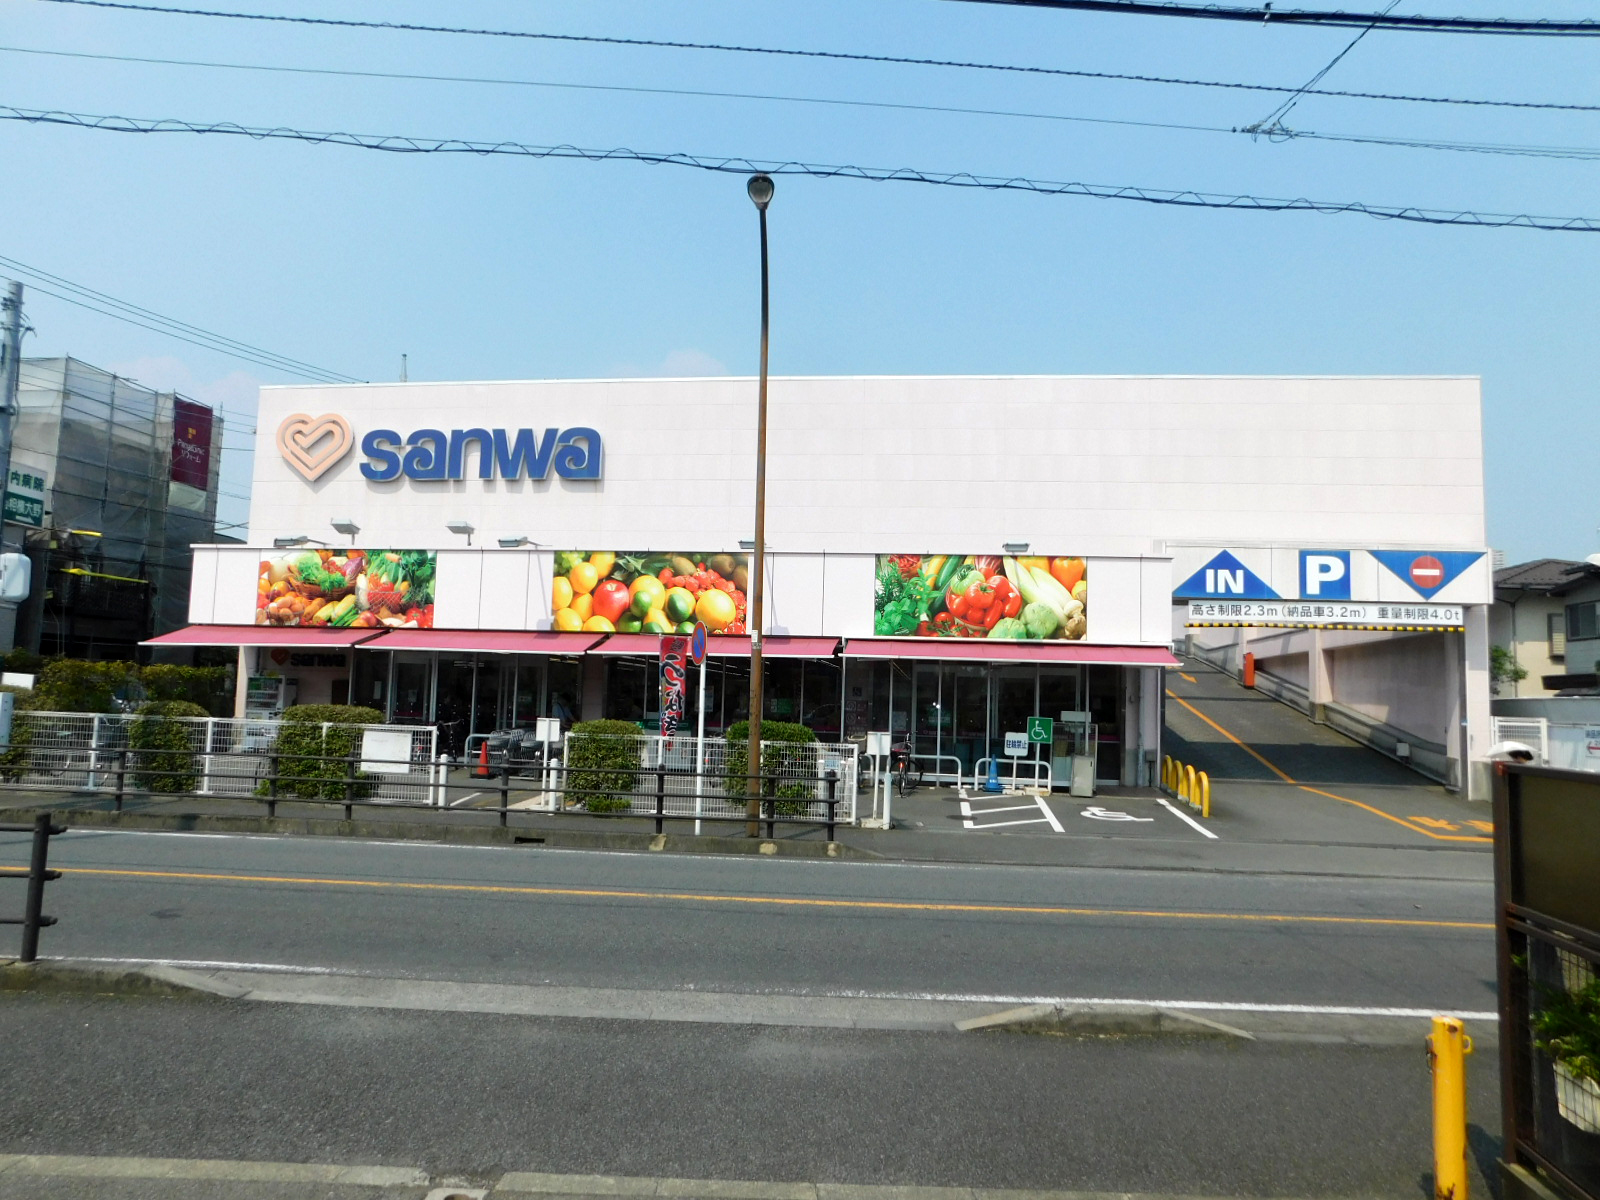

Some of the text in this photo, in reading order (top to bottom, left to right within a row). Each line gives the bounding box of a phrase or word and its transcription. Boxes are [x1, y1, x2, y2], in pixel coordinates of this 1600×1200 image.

[359, 427, 602, 481] sanwa
[1205, 568, 1244, 594] IN
[1305, 555, 1345, 595] P
[1377, 606, 1460, 621] 重量制限4.0t
